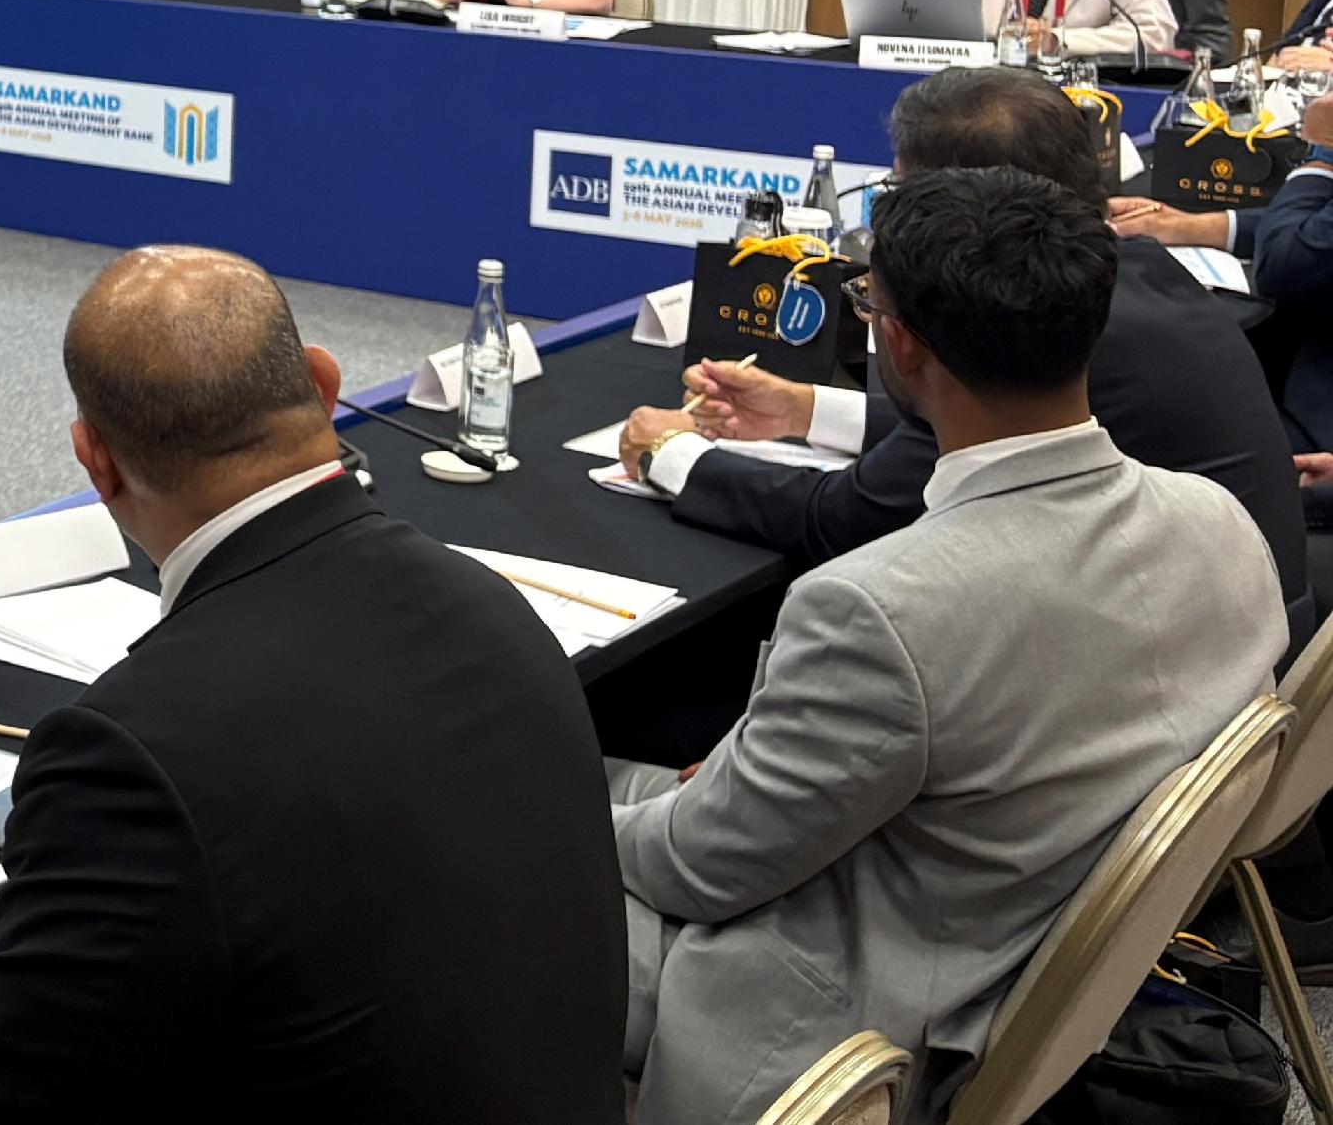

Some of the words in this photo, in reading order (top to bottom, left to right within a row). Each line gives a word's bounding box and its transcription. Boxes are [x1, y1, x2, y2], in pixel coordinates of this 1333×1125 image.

[623, 157, 801, 195] SAMARKAND
[551, 174, 609, 204] ADB
[653, 184, 712, 201] ANNUAL
[1179, 178, 1261, 197] CROSS
[624, 195, 651, 207] THE
[653, 197, 695, 212] ASIAN
[719, 305, 768, 326] CRO
